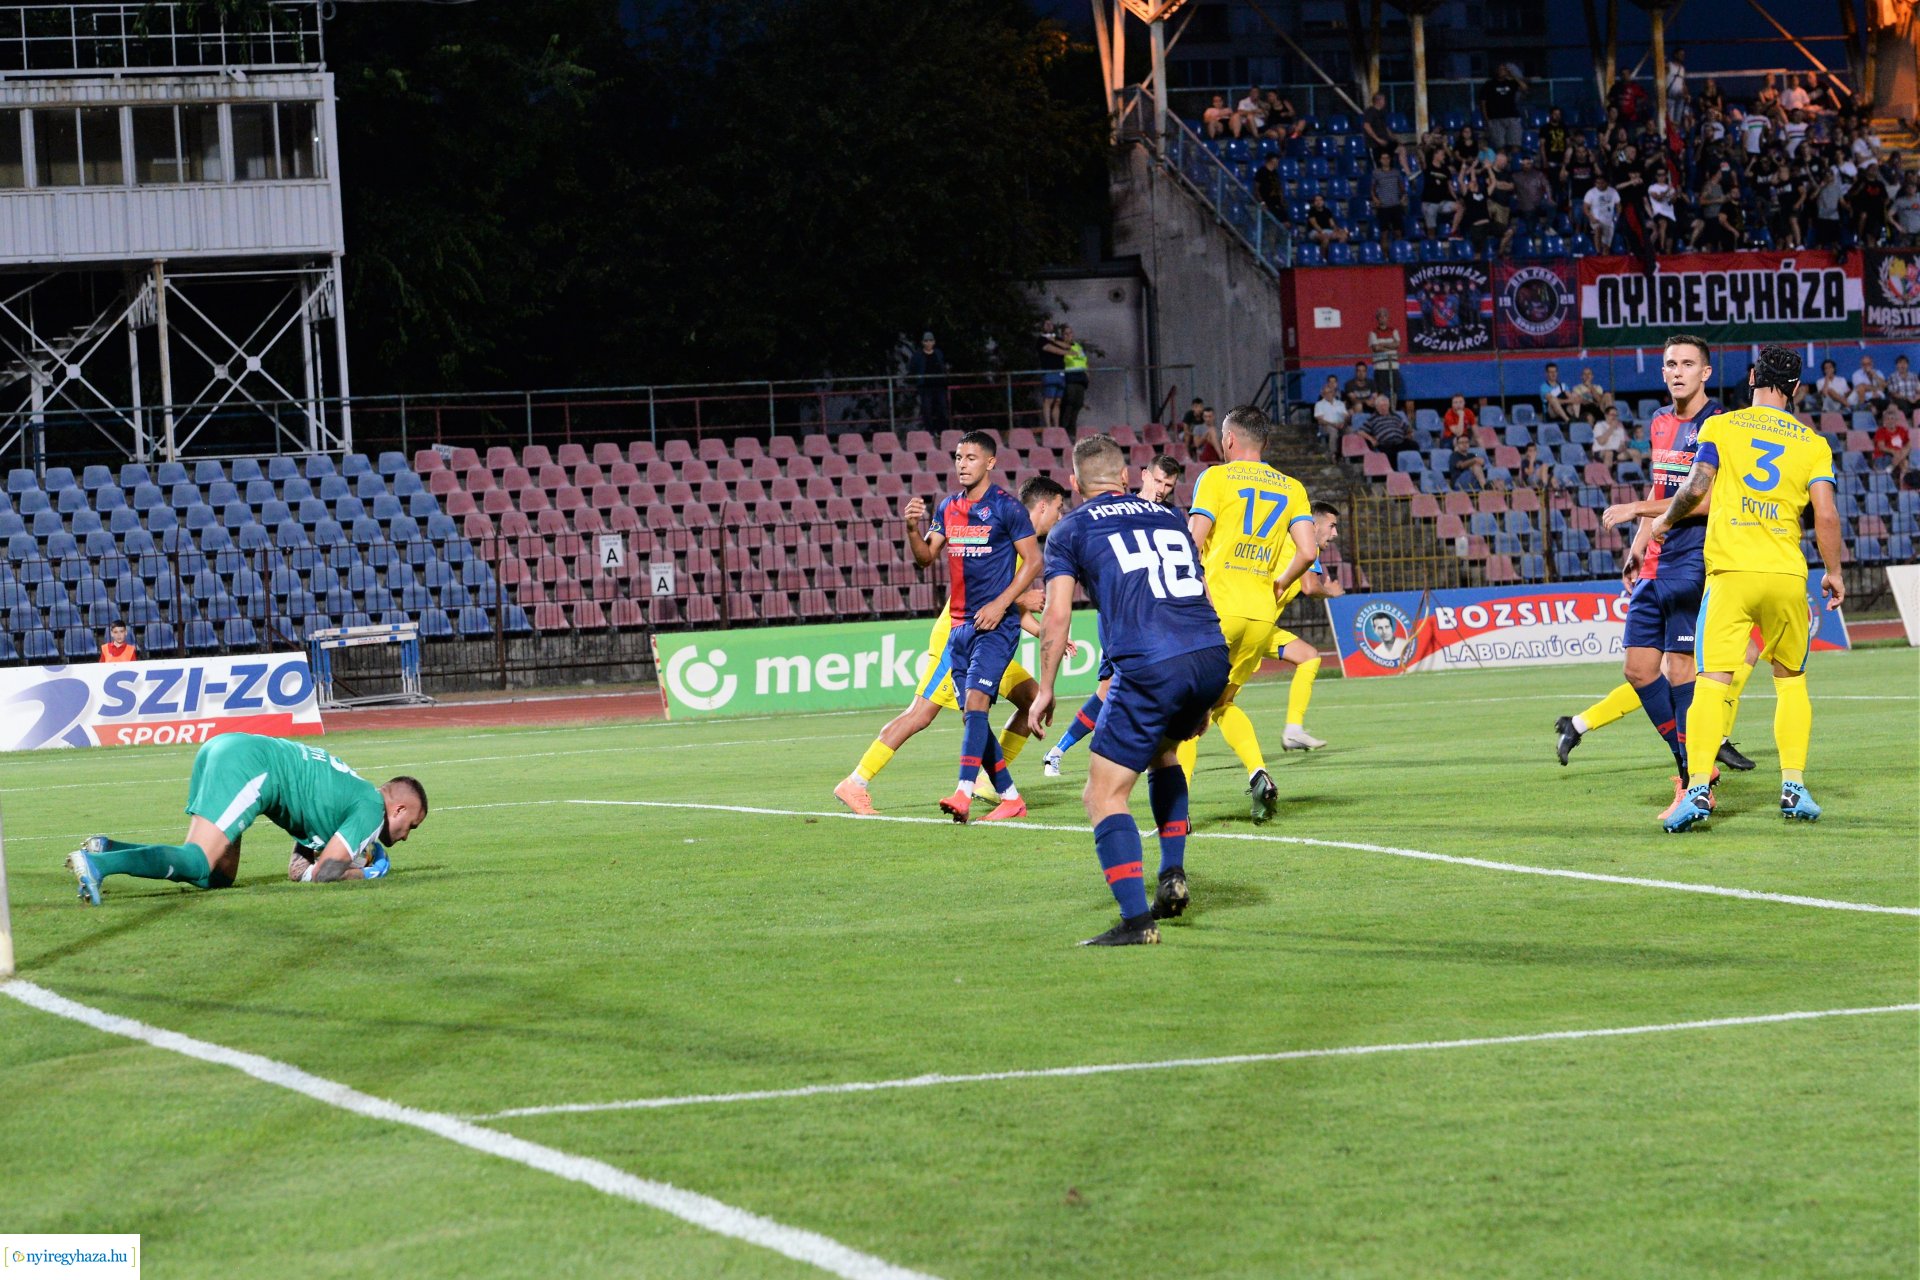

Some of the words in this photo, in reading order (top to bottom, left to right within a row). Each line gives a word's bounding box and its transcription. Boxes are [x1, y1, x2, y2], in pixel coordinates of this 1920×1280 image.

[1596, 258, 1848, 328] NYÍREGYHÁZA
[1729, 419, 1798, 439] KAZINCBARCIKA
[1743, 437, 1786, 492] 3
[1238, 487, 1289, 539] 17
[606, 548, 619, 564] A
[1107, 528, 1204, 599] 48
[1234, 542, 1272, 563] OLTEAN
[656, 576, 670, 592] A
[1434, 599, 1582, 631] BOZSIK
[1443, 632, 1602, 663] LABDARÚGÓ
[98, 660, 315, 717] SZI-ZO
[116, 722, 216, 746] SPORT
